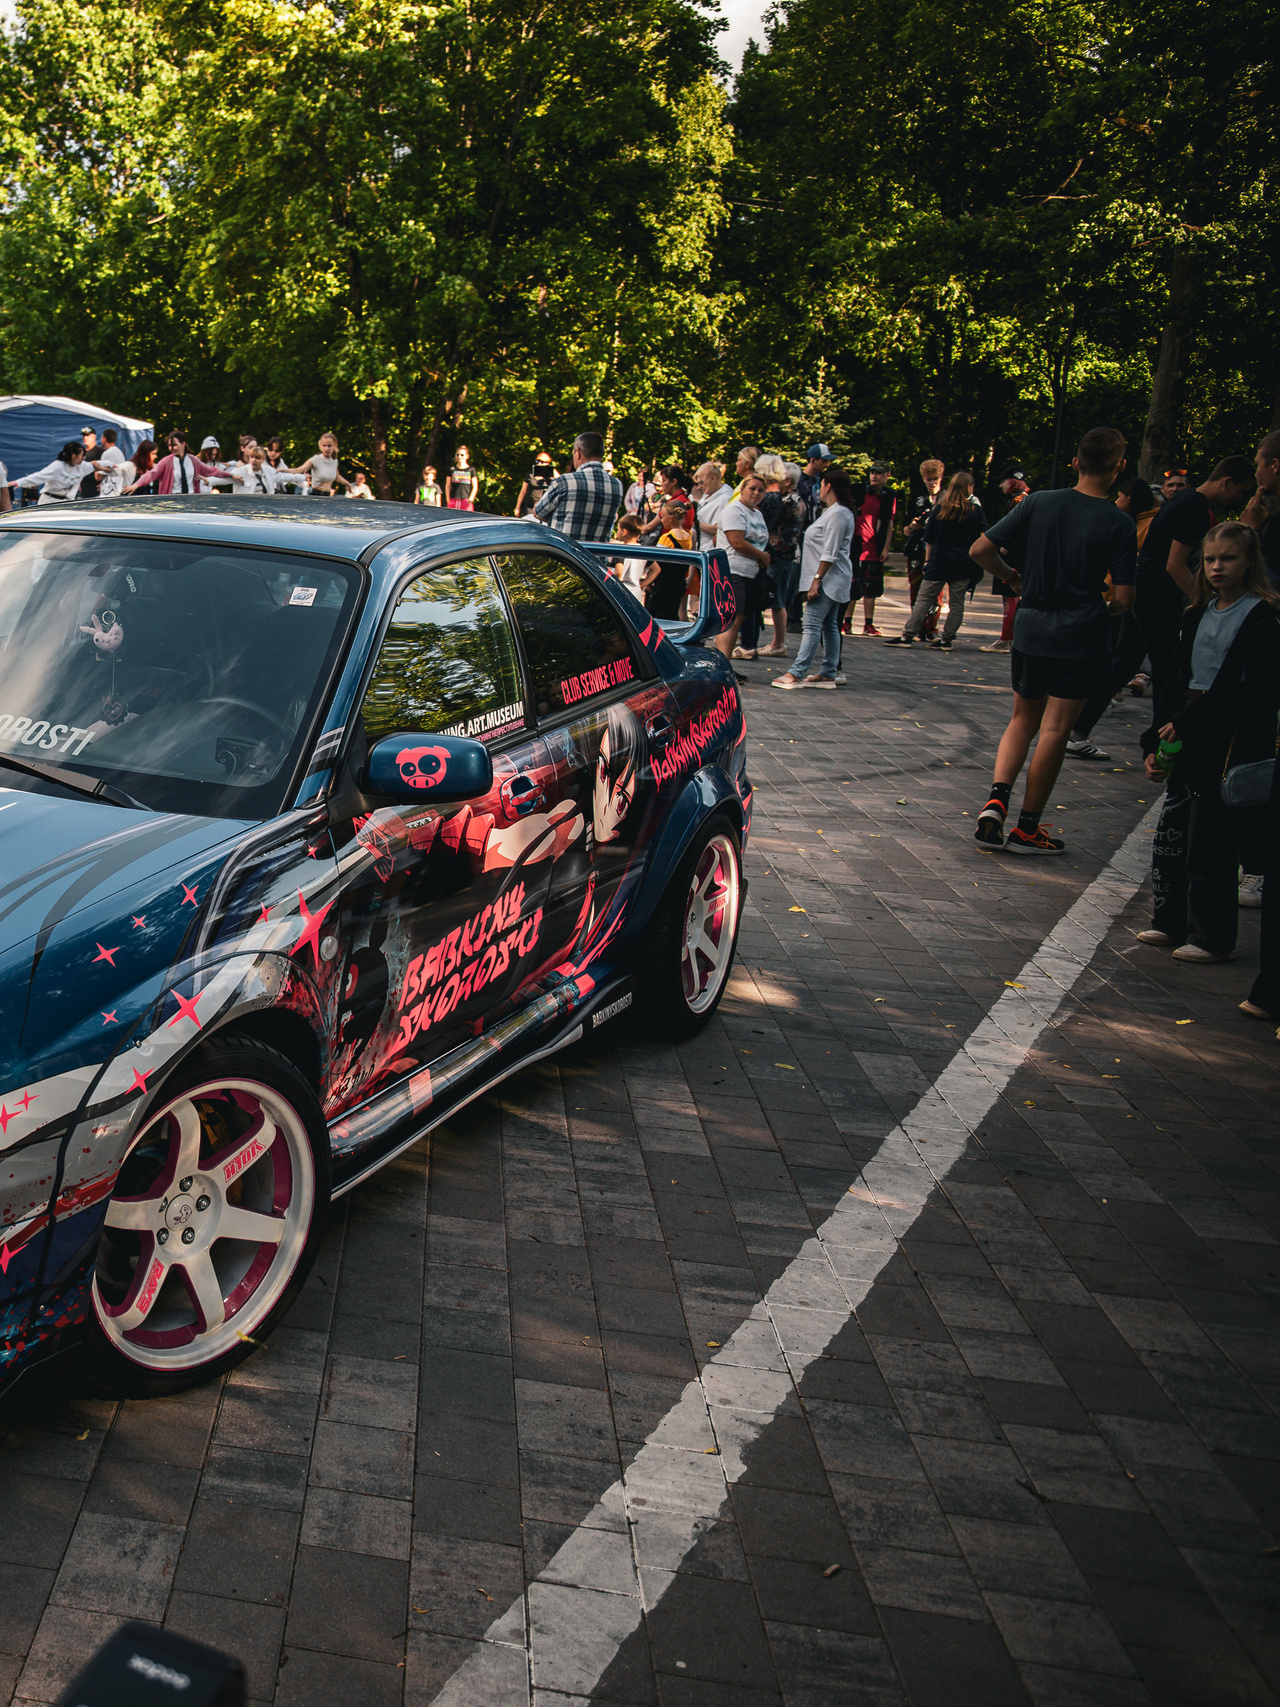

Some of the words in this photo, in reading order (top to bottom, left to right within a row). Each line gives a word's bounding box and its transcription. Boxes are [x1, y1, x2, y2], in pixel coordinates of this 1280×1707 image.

[561, 676, 582, 705] CLUB
[580, 665, 611, 698] SERVICE
[607, 663, 616, 686] &
[613, 656, 634, 684] MOVE
[386, 907, 543, 1060] SKOROSTI
[397, 881, 526, 1012] BABKINY
[140, 1259, 165, 1316] RAYS
